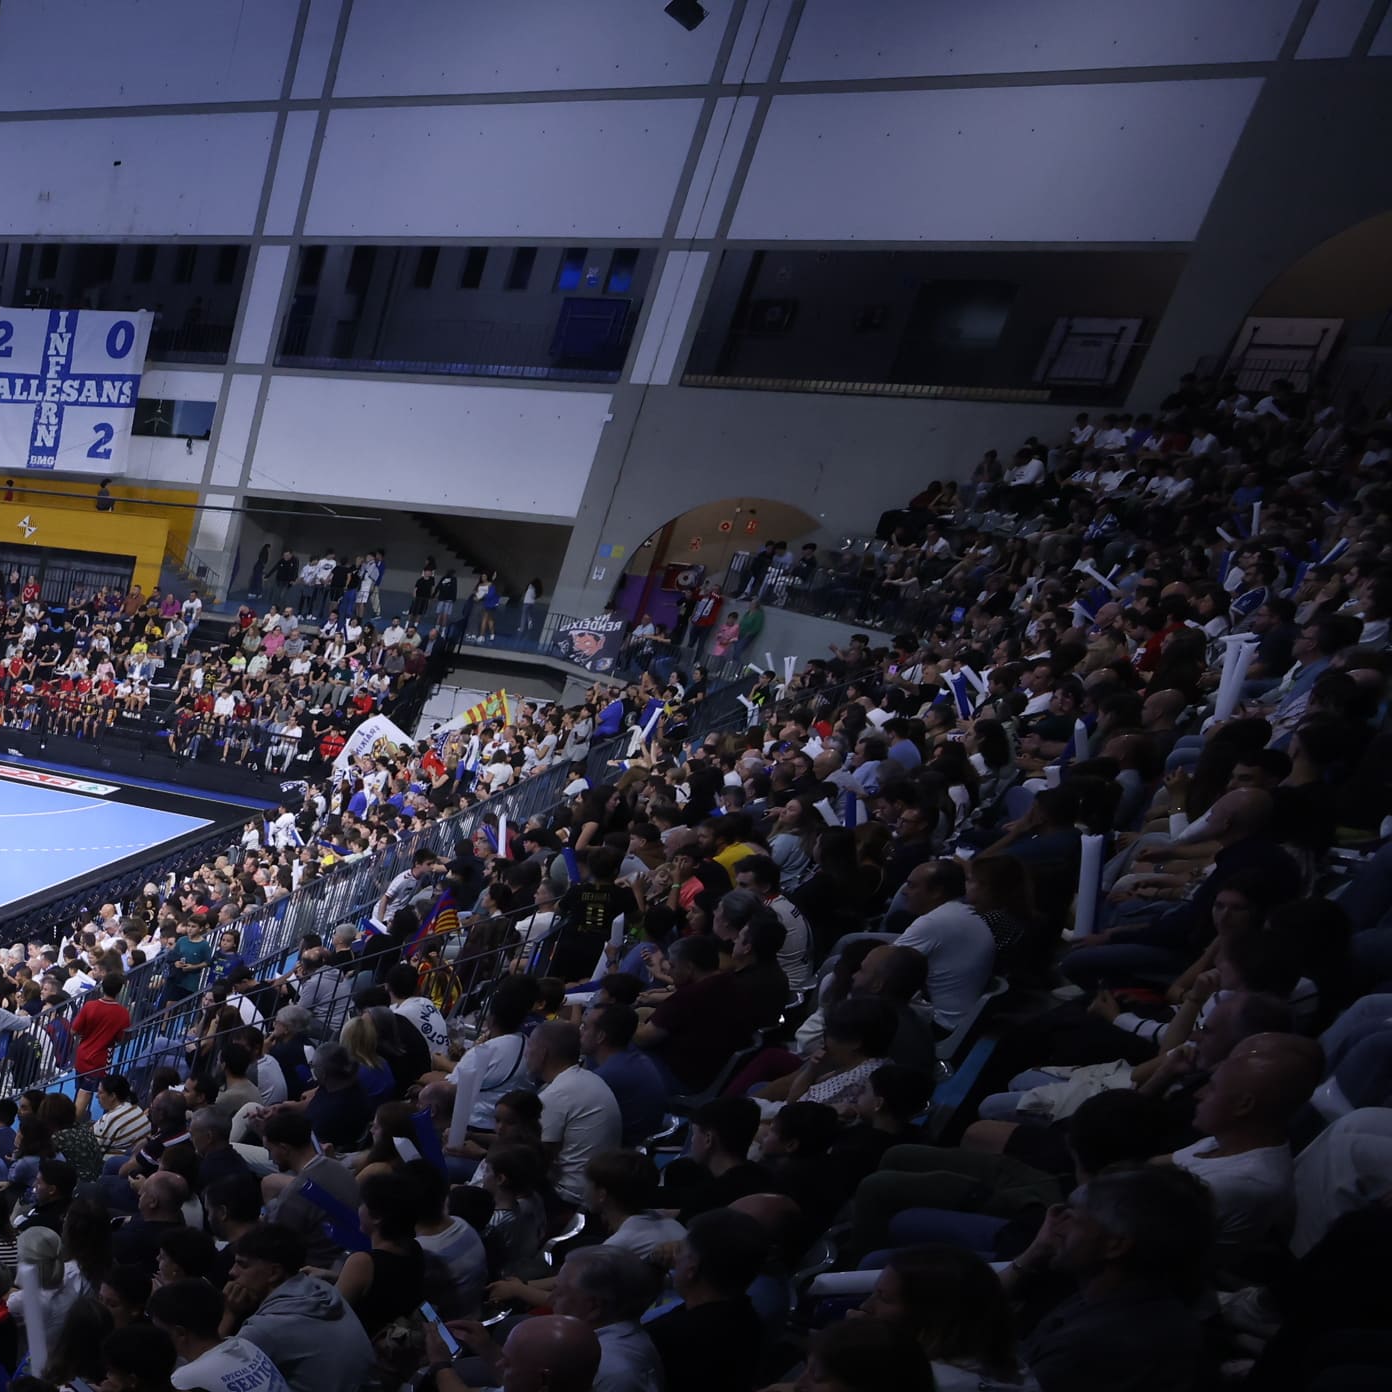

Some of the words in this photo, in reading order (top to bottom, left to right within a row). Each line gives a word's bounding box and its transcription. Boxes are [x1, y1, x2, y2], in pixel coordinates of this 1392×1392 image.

[105, 320, 135, 359] 0
[86, 422, 114, 460] 2
[29, 455, 56, 466] BMG
